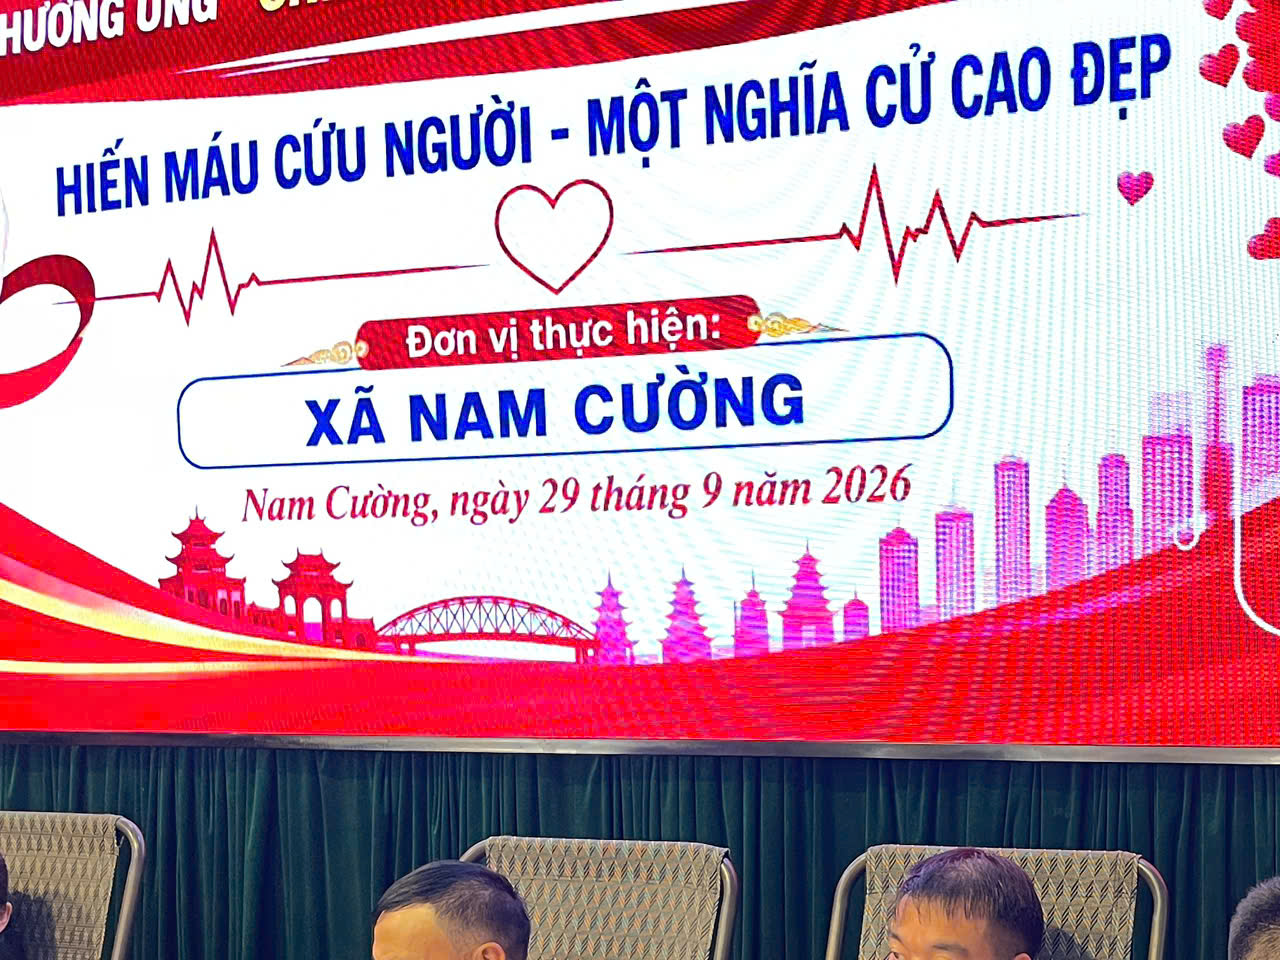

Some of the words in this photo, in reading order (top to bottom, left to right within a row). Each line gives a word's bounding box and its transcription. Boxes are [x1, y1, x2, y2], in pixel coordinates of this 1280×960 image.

[56, 138, 150, 217] HIẾN
[164, 131, 259, 203] MÁU
[274, 118, 366, 190] CỨU
[384, 95, 532, 177] NGƯỜI
[551, 128, 570, 141] -
[587, 78, 688, 169] MỘT
[704, 59, 850, 146] NGHĨA
[865, 42, 936, 129] CỬ
[951, 46, 1052, 120] CAO
[1070, 33, 1172, 121] ĐẸP
[405, 324, 477, 358] Đơn
[488, 317, 519, 360] vị
[529, 316, 614, 358] thực
[626, 306, 721, 351] hiện:
[305, 385, 386, 447] XÃ
[409, 388, 547, 443] NAM
[574, 364, 805, 435] CƯỜNG
[242, 488, 316, 522] Nam
[326, 483, 439, 527] Cường,
[450, 480, 530, 526] ngày
[538, 476, 580, 514] 29
[590, 473, 692, 519] tháng
[702, 471, 723, 509] 9
[732, 470, 813, 508] năm
[821, 462, 914, 505] 2026
